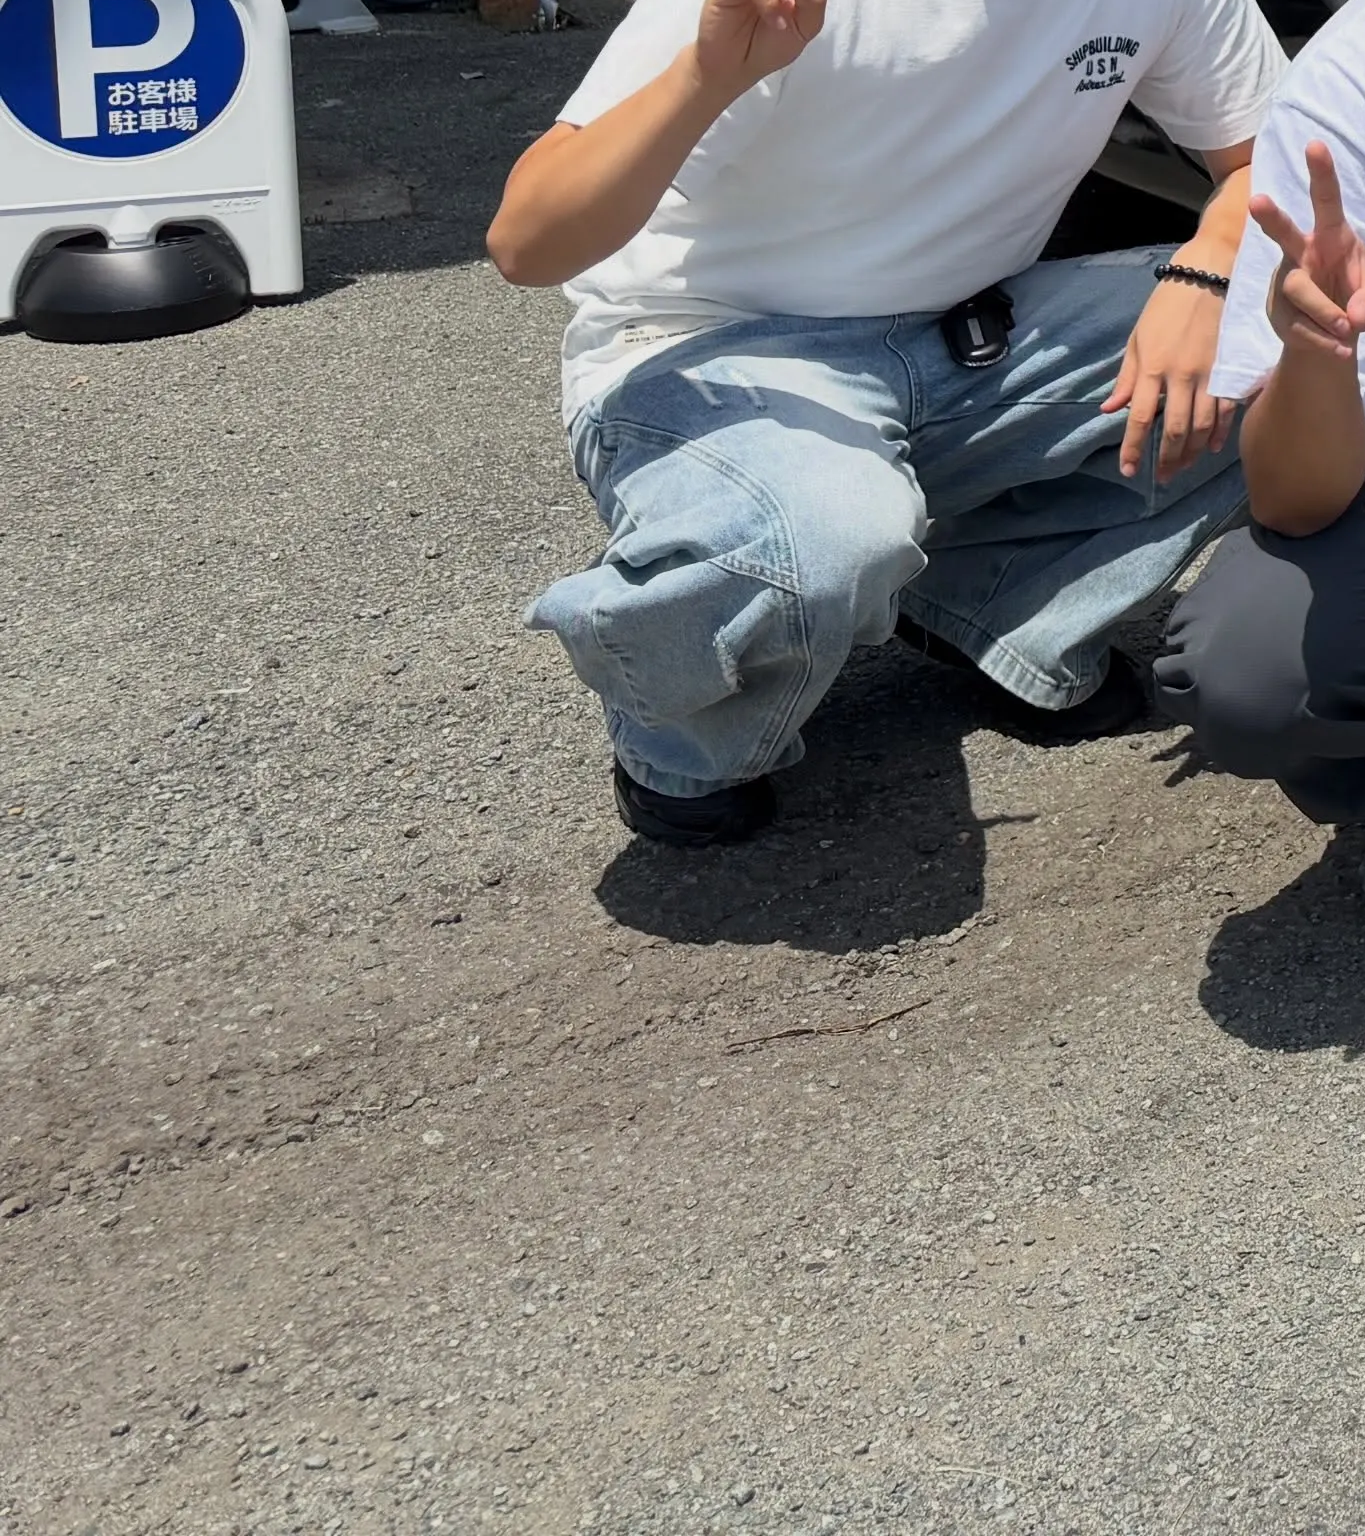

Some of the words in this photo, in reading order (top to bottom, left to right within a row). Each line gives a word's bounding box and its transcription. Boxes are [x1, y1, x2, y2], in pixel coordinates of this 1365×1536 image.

[1065, 36, 1140, 71] SHIPBUILDING
[107, 78, 198, 107] お客様
[107, 106, 199, 136] 駐車場
